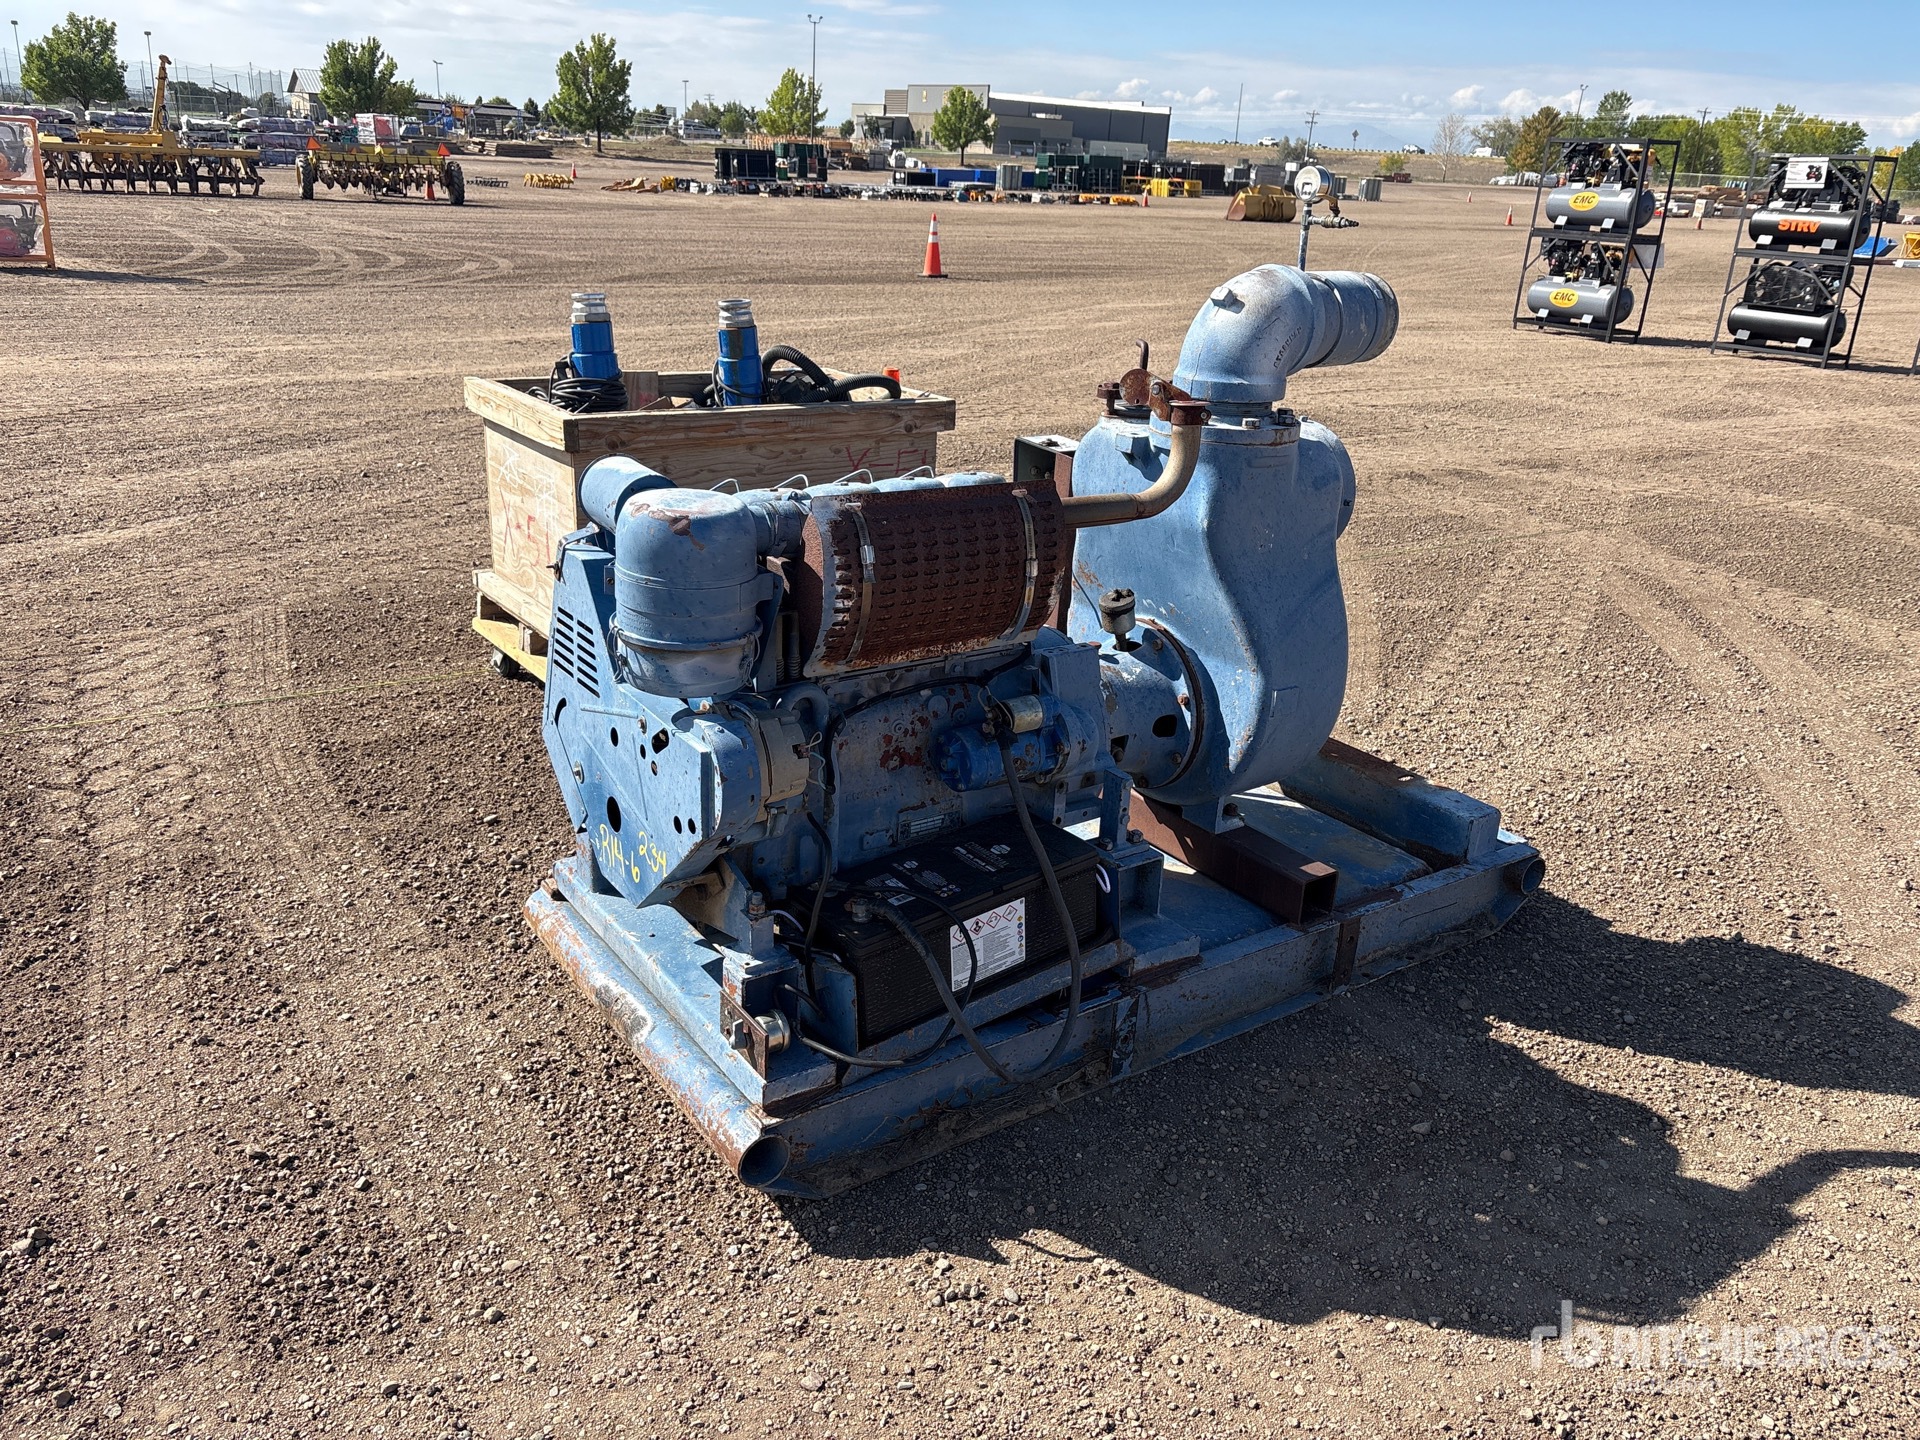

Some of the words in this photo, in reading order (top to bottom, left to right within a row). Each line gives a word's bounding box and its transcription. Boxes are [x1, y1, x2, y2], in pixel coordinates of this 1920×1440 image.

[1573, 195, 1595, 204] EMC
[1777, 219, 1822, 234] STRV
[1553, 292, 1575, 302] EMC
